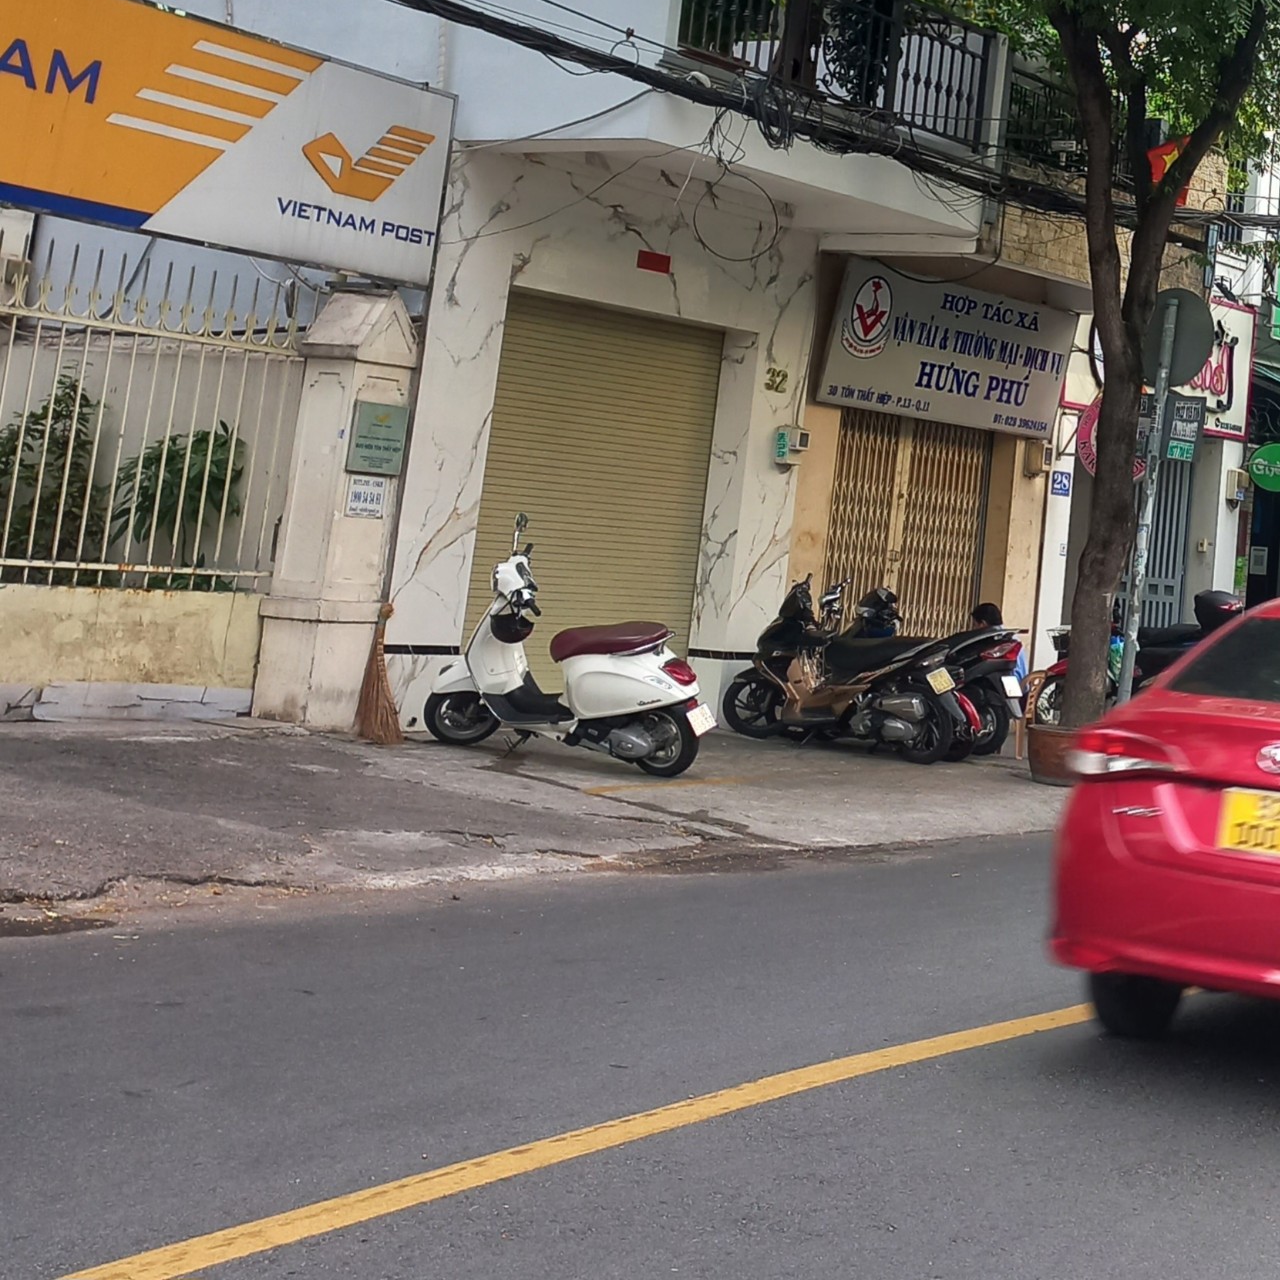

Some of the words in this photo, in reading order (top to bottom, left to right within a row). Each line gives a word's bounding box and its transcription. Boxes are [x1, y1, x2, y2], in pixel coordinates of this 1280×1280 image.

[276, 197, 376, 235] VIETNAM
[381, 222, 435, 247] POST
[940, 292, 978, 318] HỢP
[982, 300, 1014, 324] TÁC
[1014, 311, 1039, 332] XÃ
[938, 327, 950, 351] &
[764, 367, 789, 394] 32
[840, 384, 856, 399] TÔN
[915, 360, 980, 398] HƯNG
[983, 371, 1030, 407] PHÚ
[1053, 472, 1070, 490] 28
